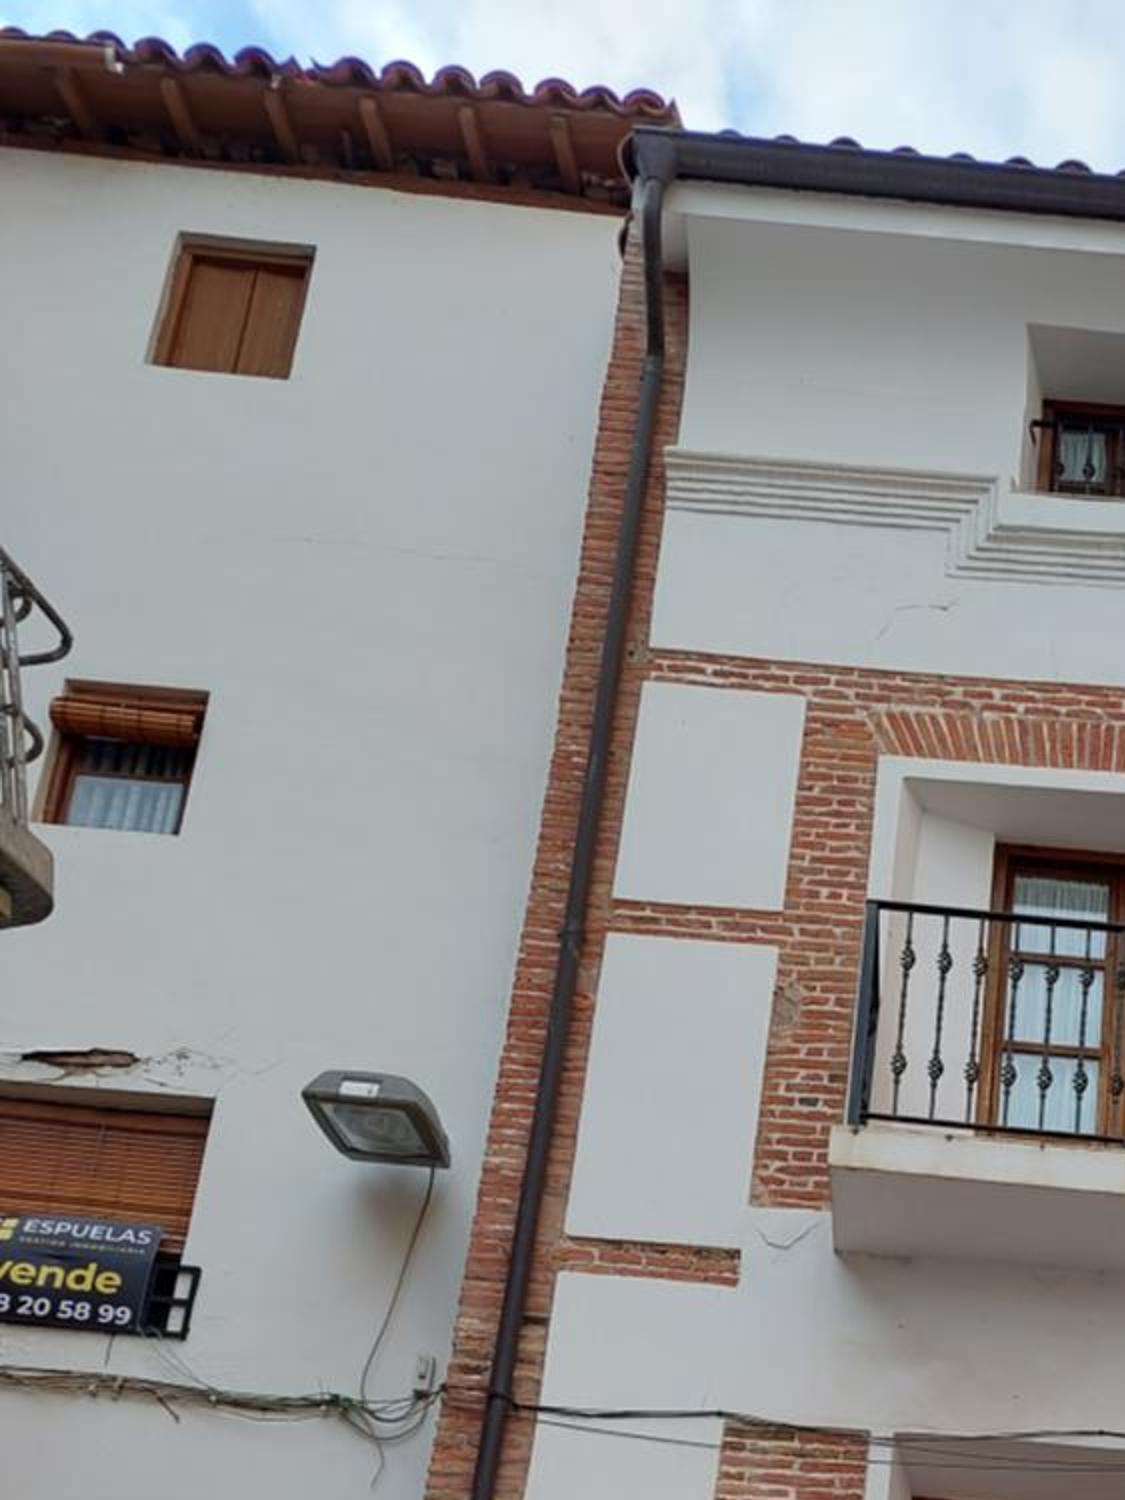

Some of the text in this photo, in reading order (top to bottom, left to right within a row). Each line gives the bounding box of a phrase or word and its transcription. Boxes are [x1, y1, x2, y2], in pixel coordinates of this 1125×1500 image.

[23, 1217, 152, 1245] ESPUELAS
[16, 1295, 50, 1317] 20
[56, 1299, 91, 1321] 58
[97, 1303, 132, 1326] 99
